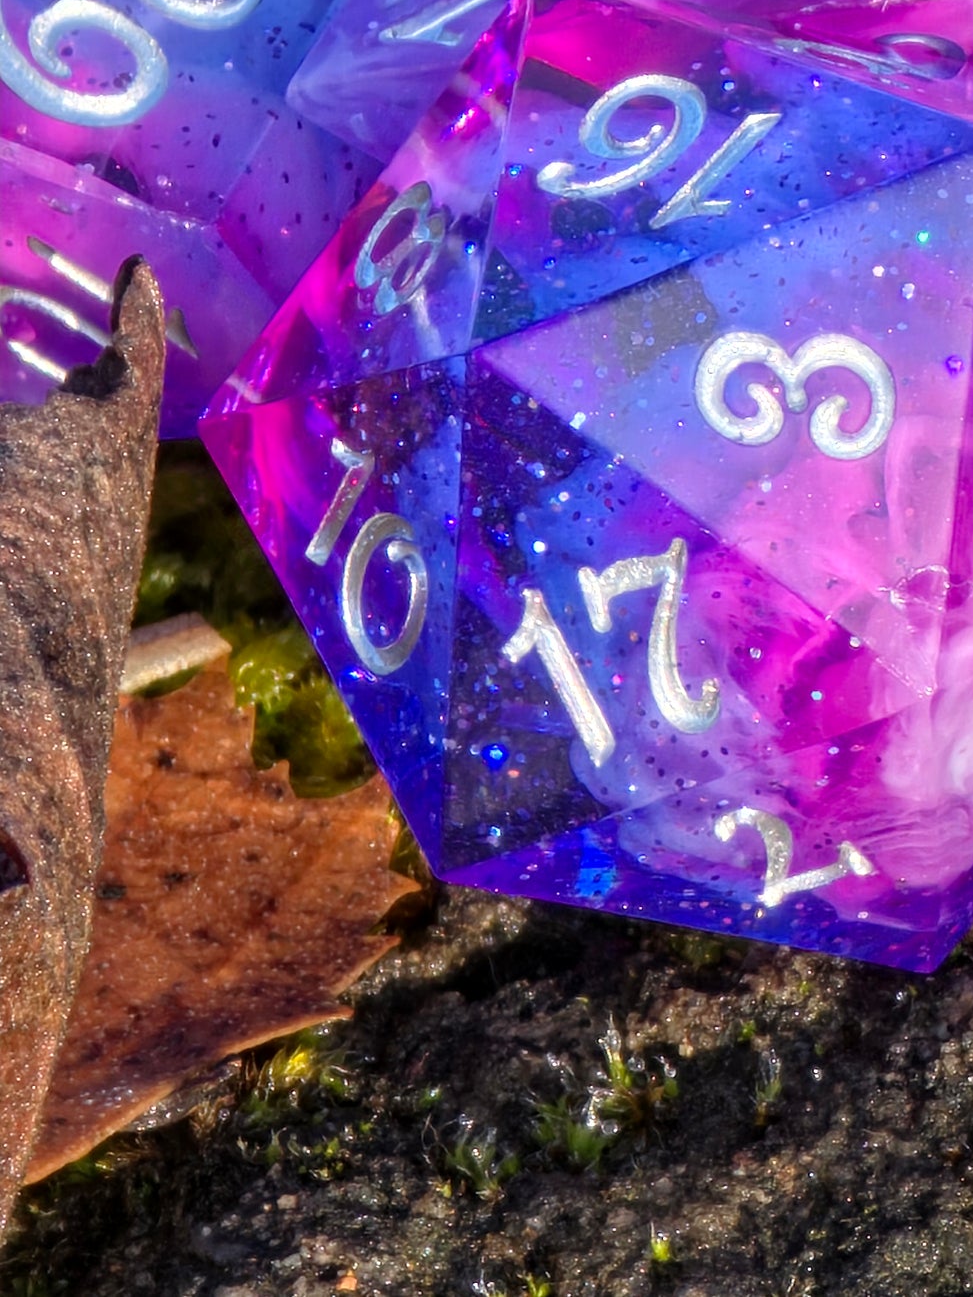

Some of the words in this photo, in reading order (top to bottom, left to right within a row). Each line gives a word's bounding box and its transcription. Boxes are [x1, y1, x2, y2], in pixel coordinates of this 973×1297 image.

[694, 331, 896, 460] 3
[304, 436, 428, 675] 10
[502, 537, 722, 766] 17
